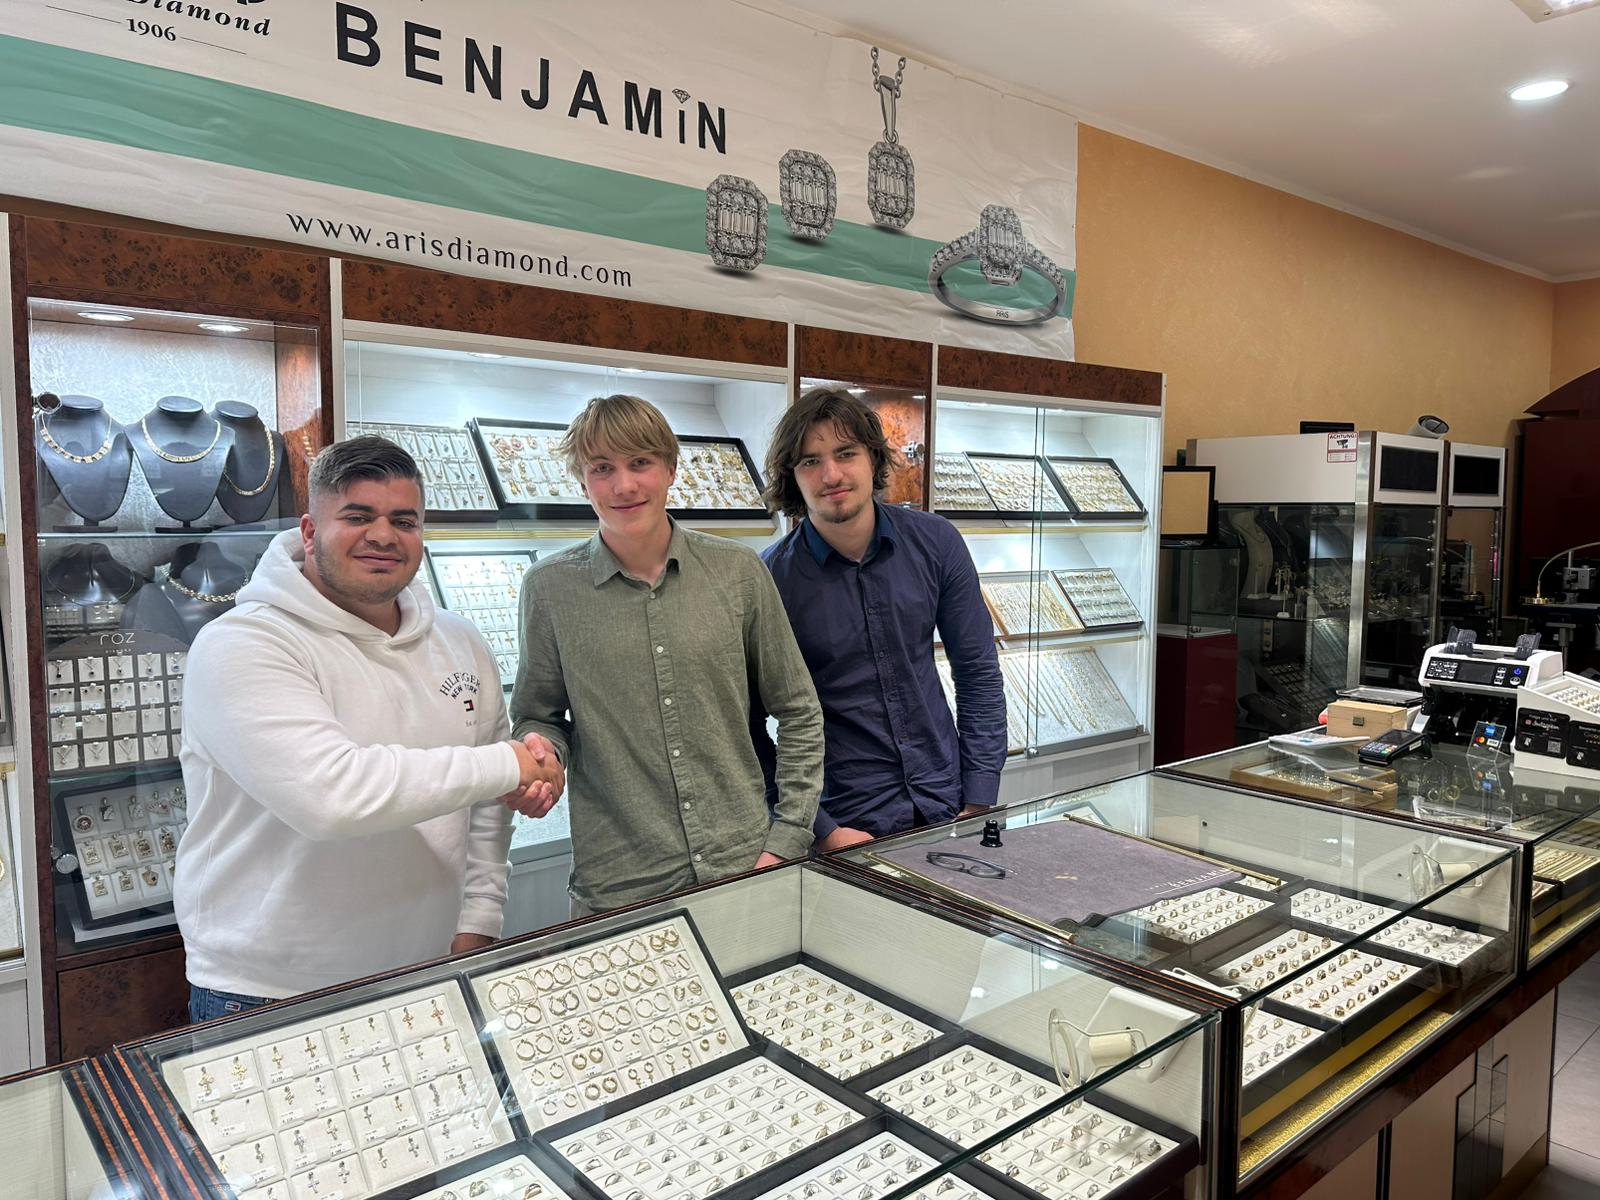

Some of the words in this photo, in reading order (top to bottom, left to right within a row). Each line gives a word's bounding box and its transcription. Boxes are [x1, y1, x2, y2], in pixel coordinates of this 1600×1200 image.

[126, 18, 177, 42] 1906
[128, 0, 271, 36] amond
[286, 213, 632, 288] www.arisdiamond.com
[450, 684, 463, 700] NEW
